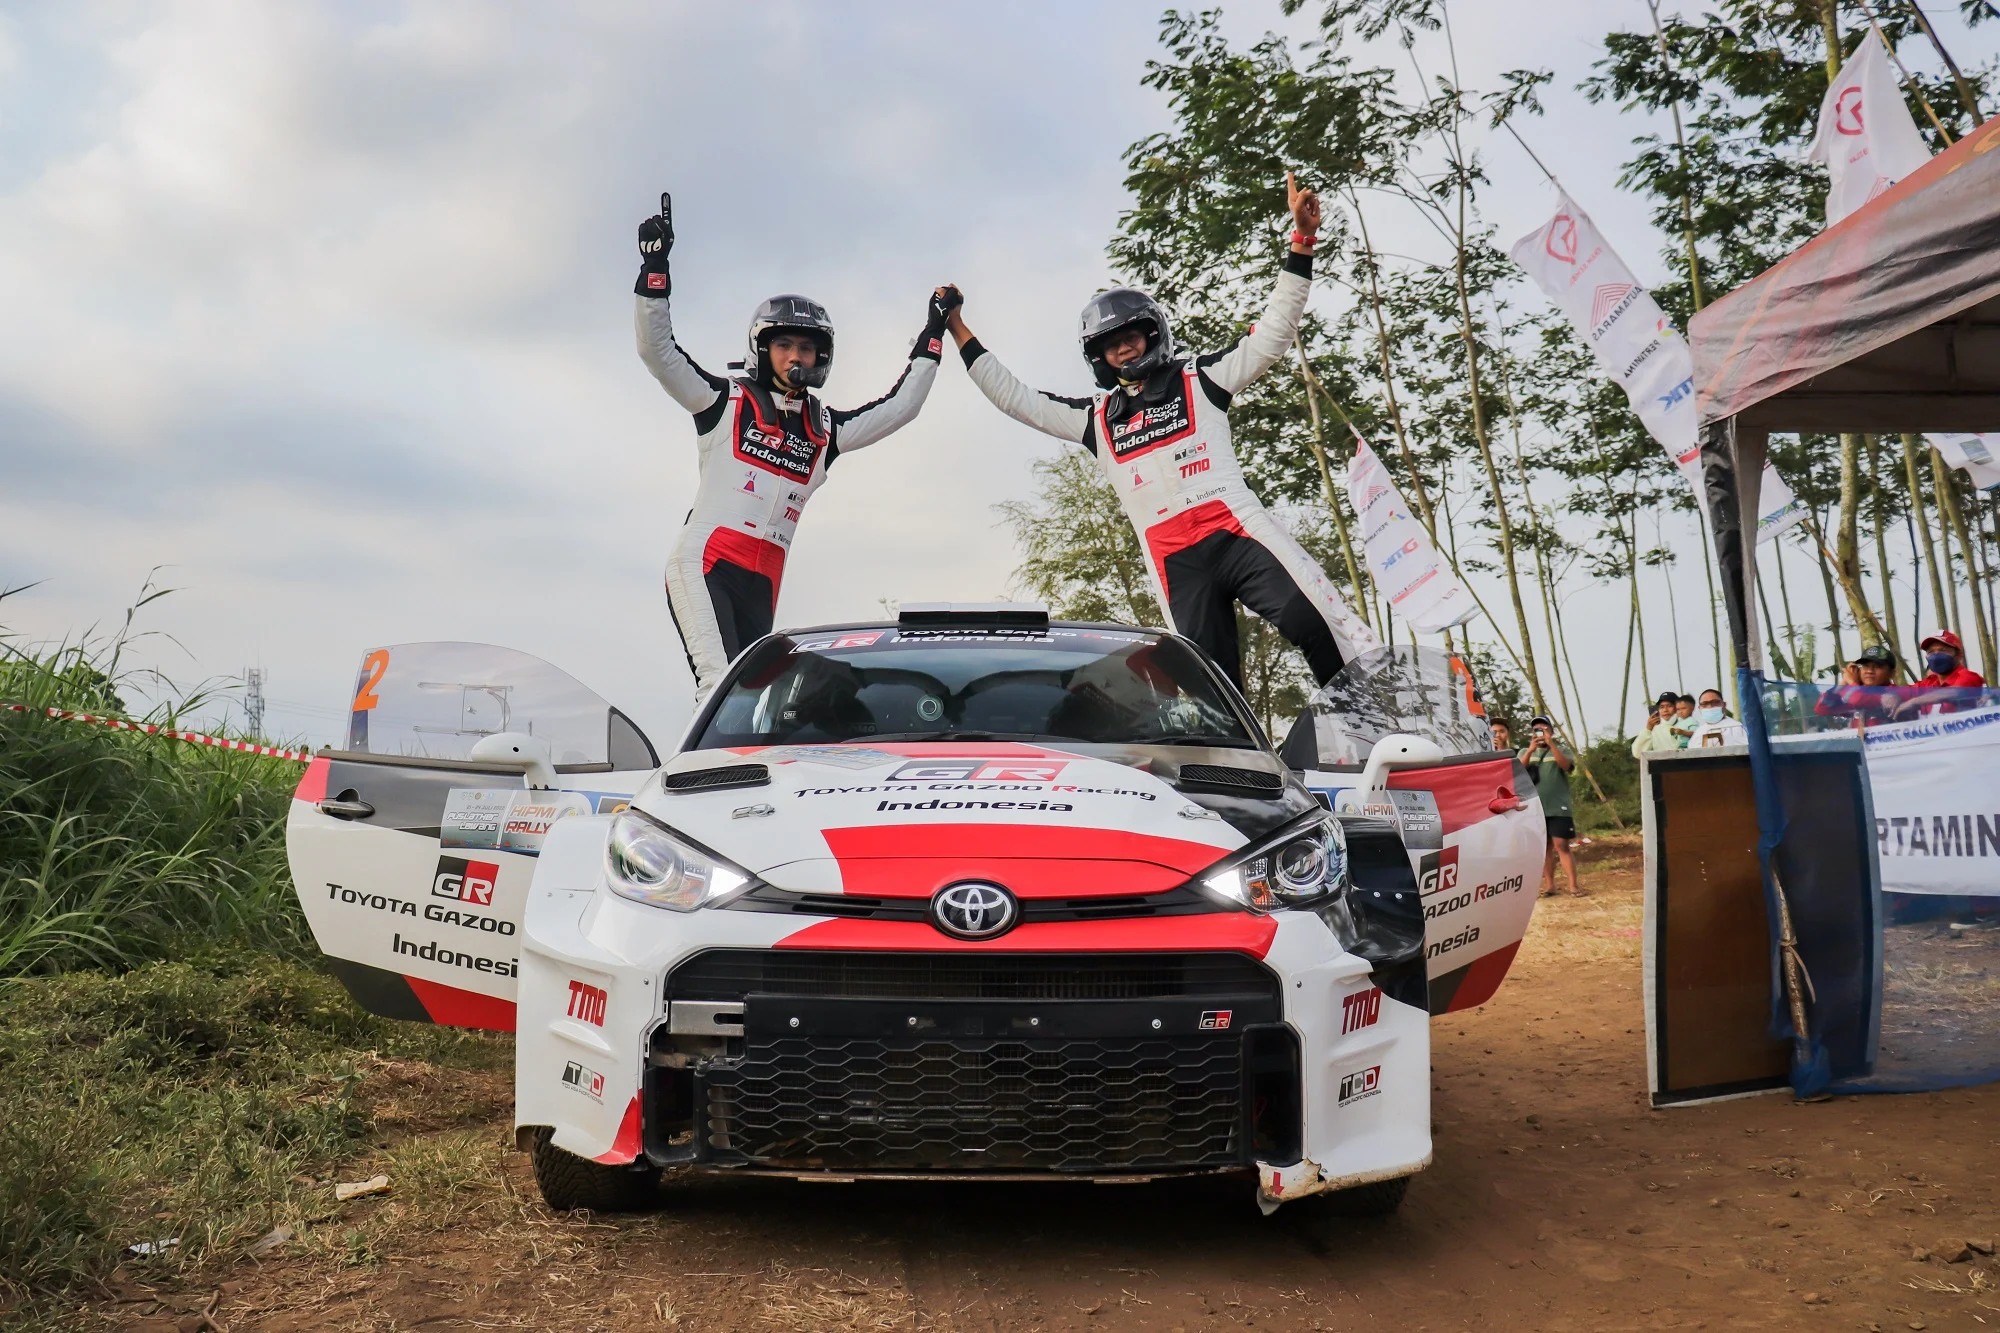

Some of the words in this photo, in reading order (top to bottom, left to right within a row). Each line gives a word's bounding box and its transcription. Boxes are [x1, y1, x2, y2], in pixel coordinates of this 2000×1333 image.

[746, 428, 782, 450] GR
[1115, 418, 1188, 453] Indonesia
[740, 441, 811, 475] Indonesia
[1179, 457, 1211, 479] TMO
[1196, 485, 1227, 501] Indiarto
[797, 636, 874, 653] GR
[890, 635, 1055, 643] Indonesia
[994, 629, 1077, 638] GAZOO
[1083, 632, 1158, 646] Racing
[352, 649, 390, 712] 2
[1903, 724, 1941, 740] RALLY
[1943, 711, 2000, 734] INDONES
[794, 785, 918, 798] TOYOTA
[927, 783, 1043, 791] GAZOO
[1051, 785, 1157, 801] Racing
[876, 799, 1074, 812] Indonesia
[510, 805, 557, 818] HIPMI
[1362, 804, 1394, 816] HIPMI
[504, 820, 553, 835] RALLY
[1875, 814, 2000, 857] RTAMIN
[433, 872, 493, 905] GR
[1420, 862, 1457, 896] GR
[326, 883, 417, 917] TOYOTA
[424, 904, 516, 936] GAZOO
[1423, 892, 1471, 921] AZOO
[1474, 874, 1523, 903] Racing
[392, 933, 519, 978] Indonesi
[1427, 925, 1480, 960] nesia
[567, 979, 608, 1027] TMO
[1342, 986, 1382, 1036] TMO
[564, 1061, 604, 1097] TCD
[1341, 1067, 1379, 1099] TCD
